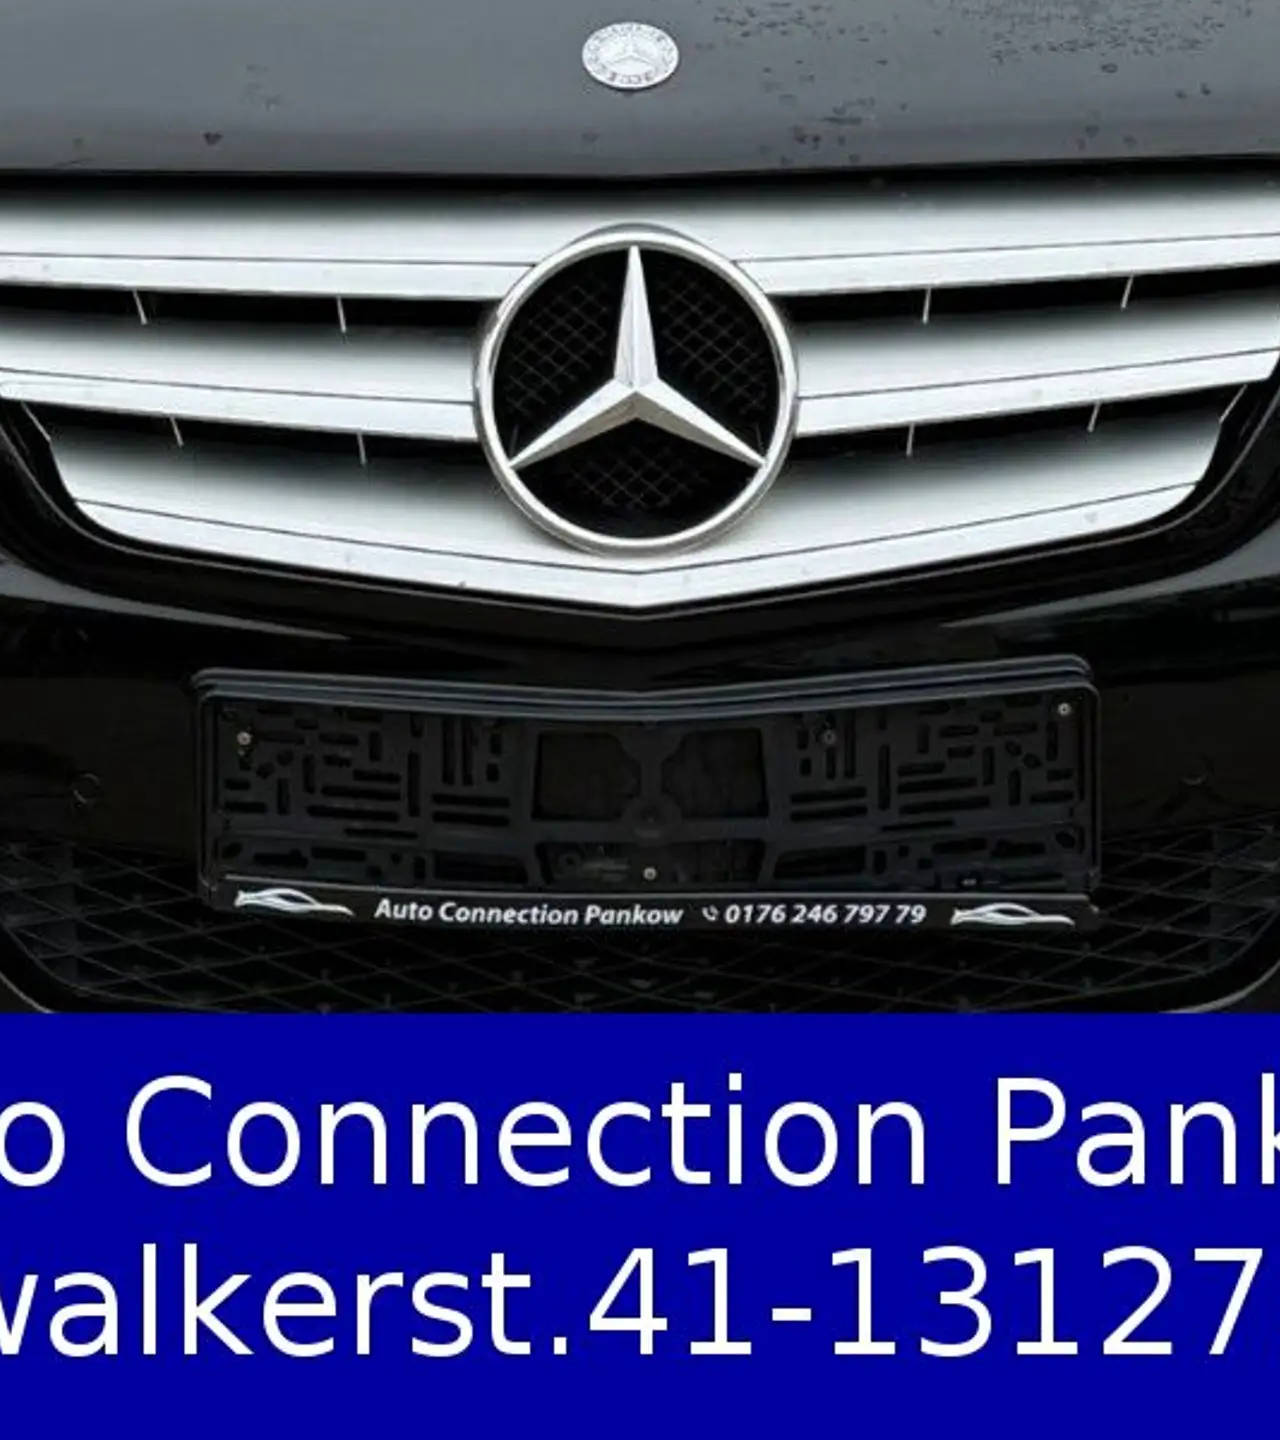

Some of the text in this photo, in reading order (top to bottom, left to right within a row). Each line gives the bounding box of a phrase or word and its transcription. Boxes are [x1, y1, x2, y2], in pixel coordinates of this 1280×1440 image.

[374, 897, 928, 926] Auto Connection Pankow 0176 246 797 79
